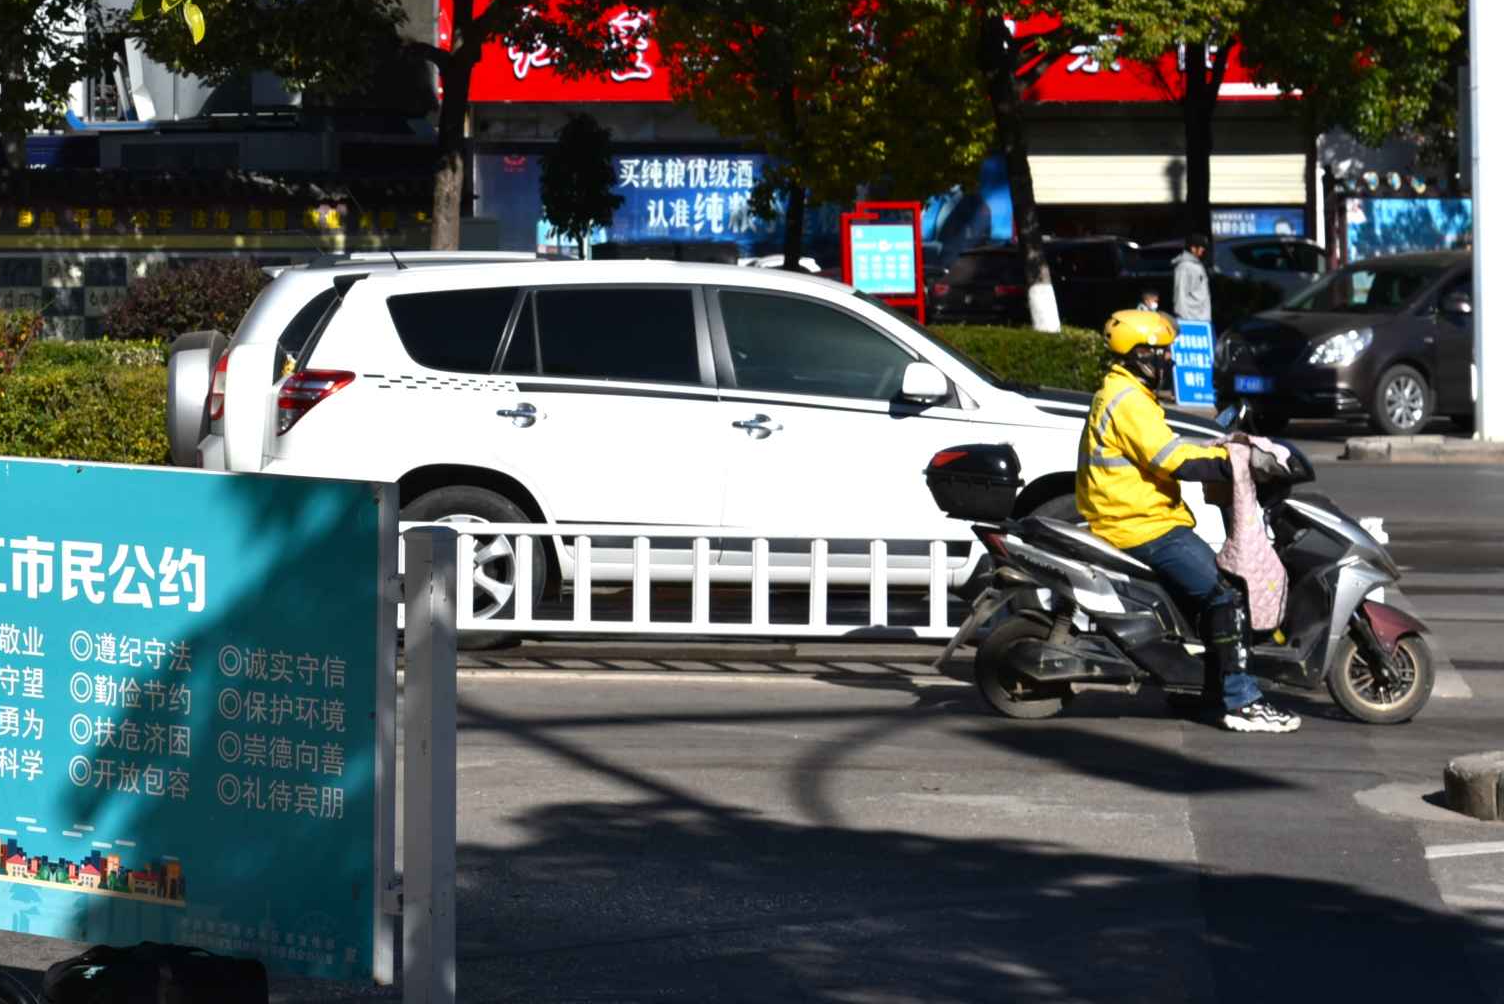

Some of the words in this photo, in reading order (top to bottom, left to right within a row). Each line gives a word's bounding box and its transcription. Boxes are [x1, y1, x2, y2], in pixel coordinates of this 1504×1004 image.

[619, 157, 753, 189] 买纯粮优级酒
[15, 205, 58, 229] 自由
[94, 632, 192, 673] 遵纪守法
[243, 647, 347, 689] 诚实守信
[93, 673, 192, 716] 勤俭节约
[243, 689, 347, 734] 保护环境
[94, 716, 192, 758] 扶危济困
[243, 732, 346, 778] 崇德向善
[93, 756, 191, 800] 开放包容
[242, 774, 345, 821] 礼待宾朋
